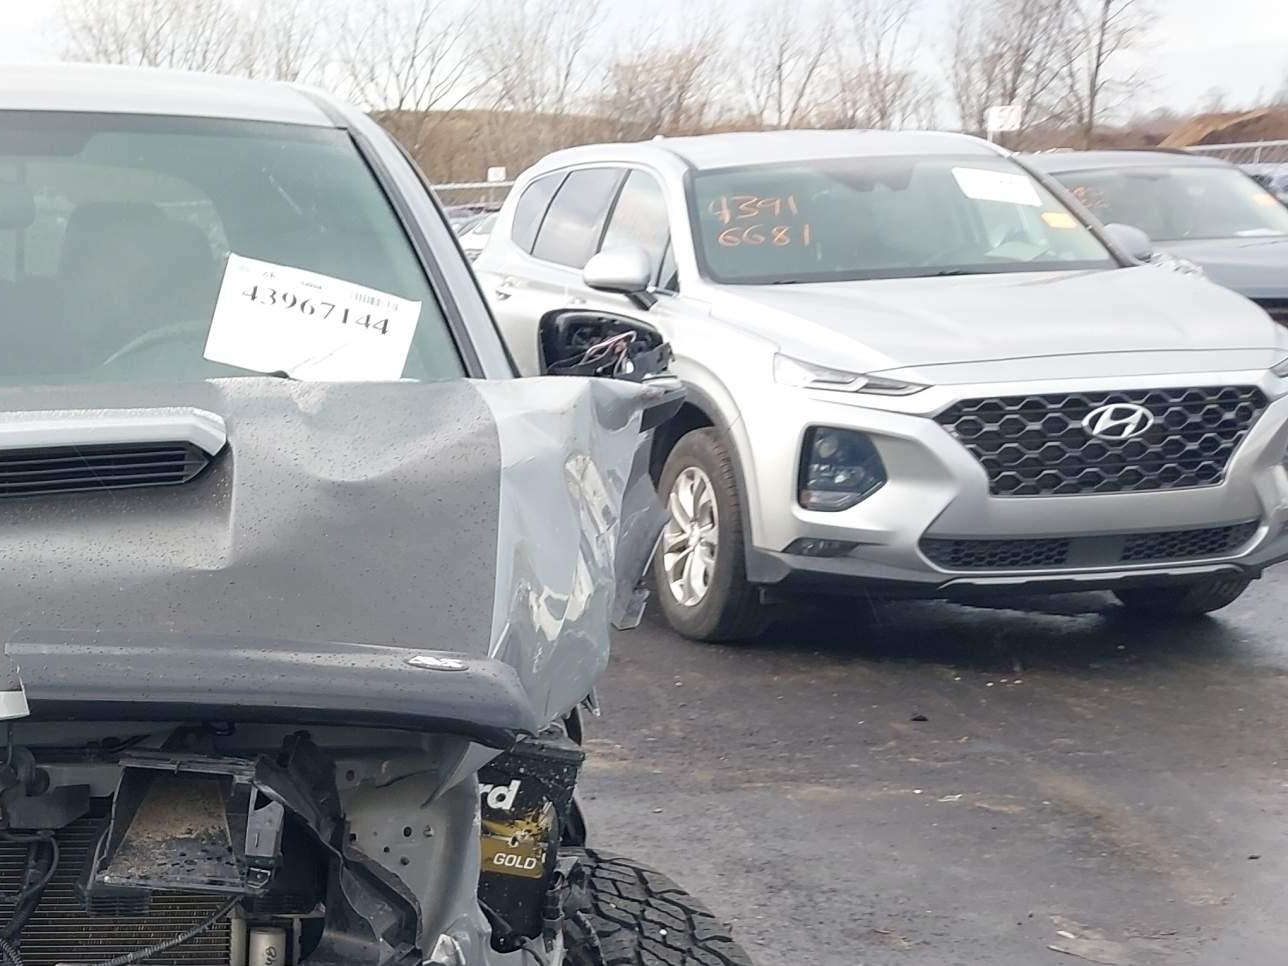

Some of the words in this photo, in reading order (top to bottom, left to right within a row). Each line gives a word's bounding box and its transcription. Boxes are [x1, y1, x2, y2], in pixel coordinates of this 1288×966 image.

[707, 194, 799, 225] 4391
[717, 223, 810, 248] 6681
[242, 284, 390, 335] 43967144
[493, 852, 537, 870] GOLD
